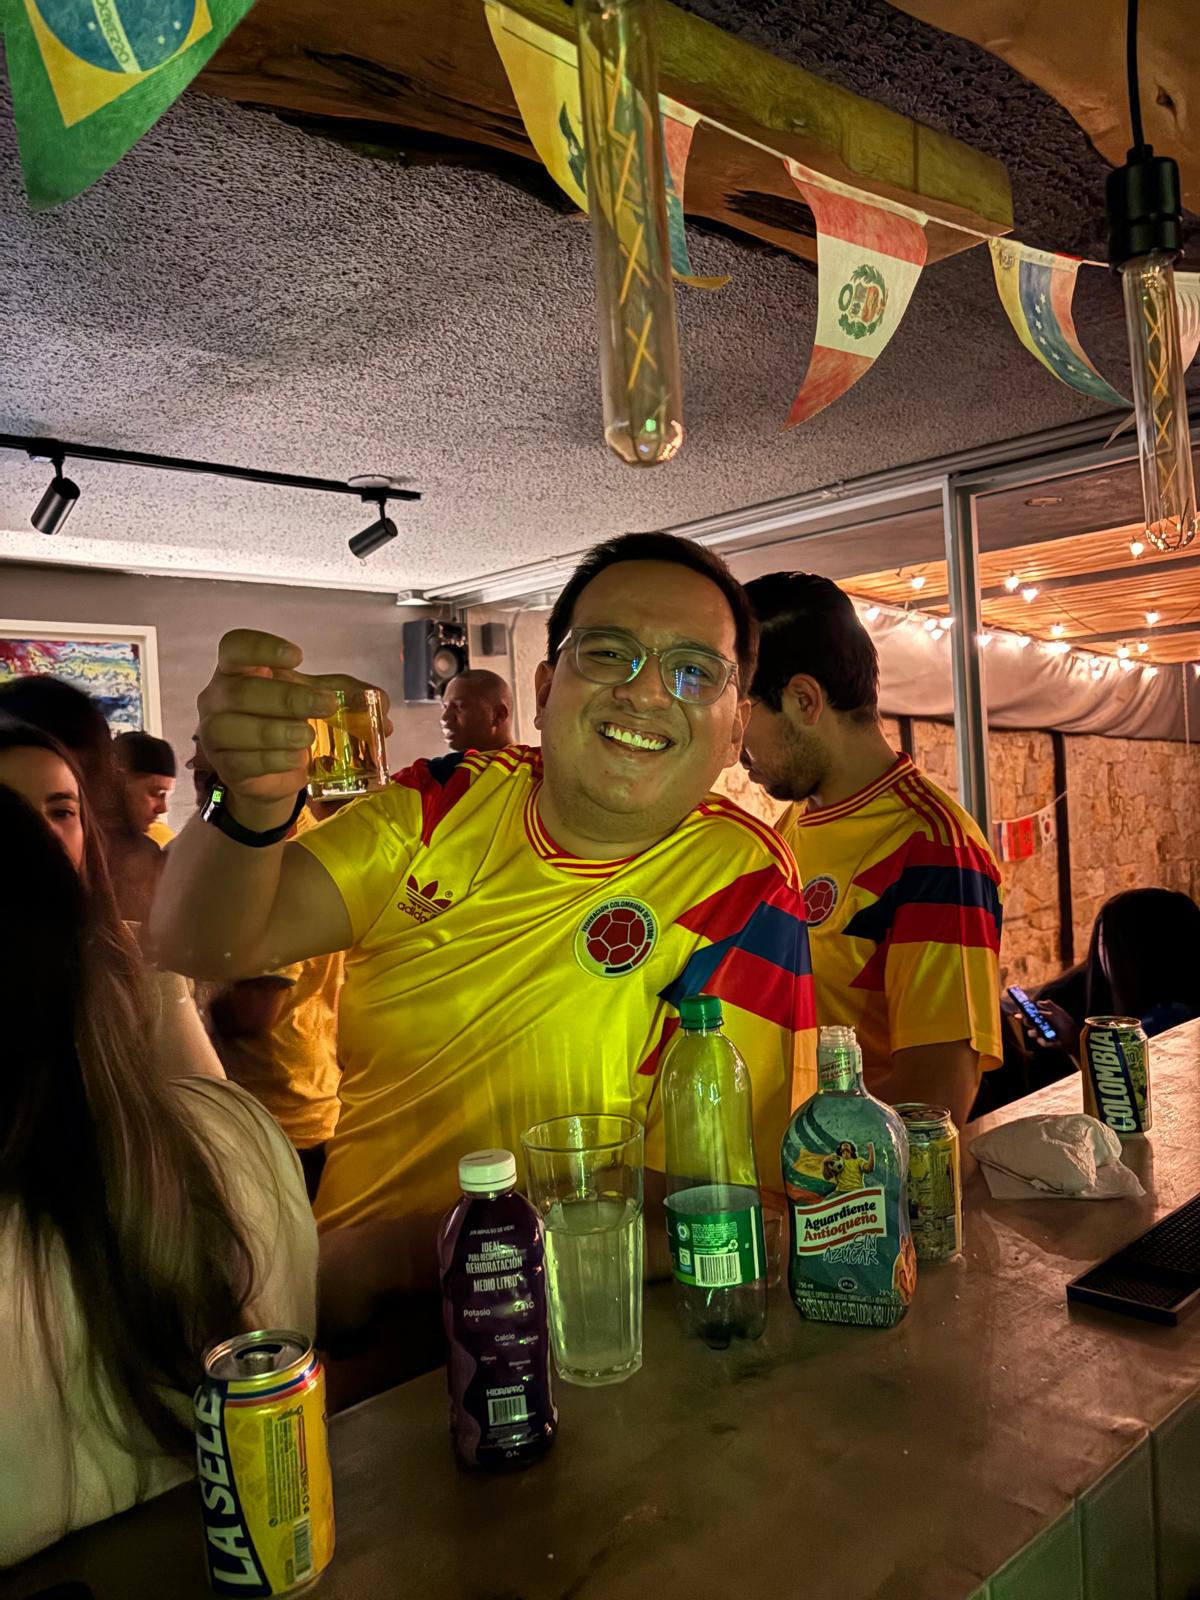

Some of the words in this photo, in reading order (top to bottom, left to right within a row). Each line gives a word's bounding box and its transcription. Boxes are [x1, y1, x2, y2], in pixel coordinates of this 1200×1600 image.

[397, 902, 430, 924] adida
[1089, 1031, 1137, 1132] COLOMBIA
[803, 1212, 878, 1243] Antioqueño
[804, 1201, 877, 1232] Aguardiente
[481, 1240, 501, 1253] IDEAL
[852, 1232, 879, 1250] SIN
[465, 1255, 523, 1274] REHIDRATACIÓN
[473, 1278, 496, 1292] MEDIO
[463, 1307, 491, 1317] Potasio
[193, 1384, 236, 1515] SELE
[206, 1524, 263, 1586] LA
